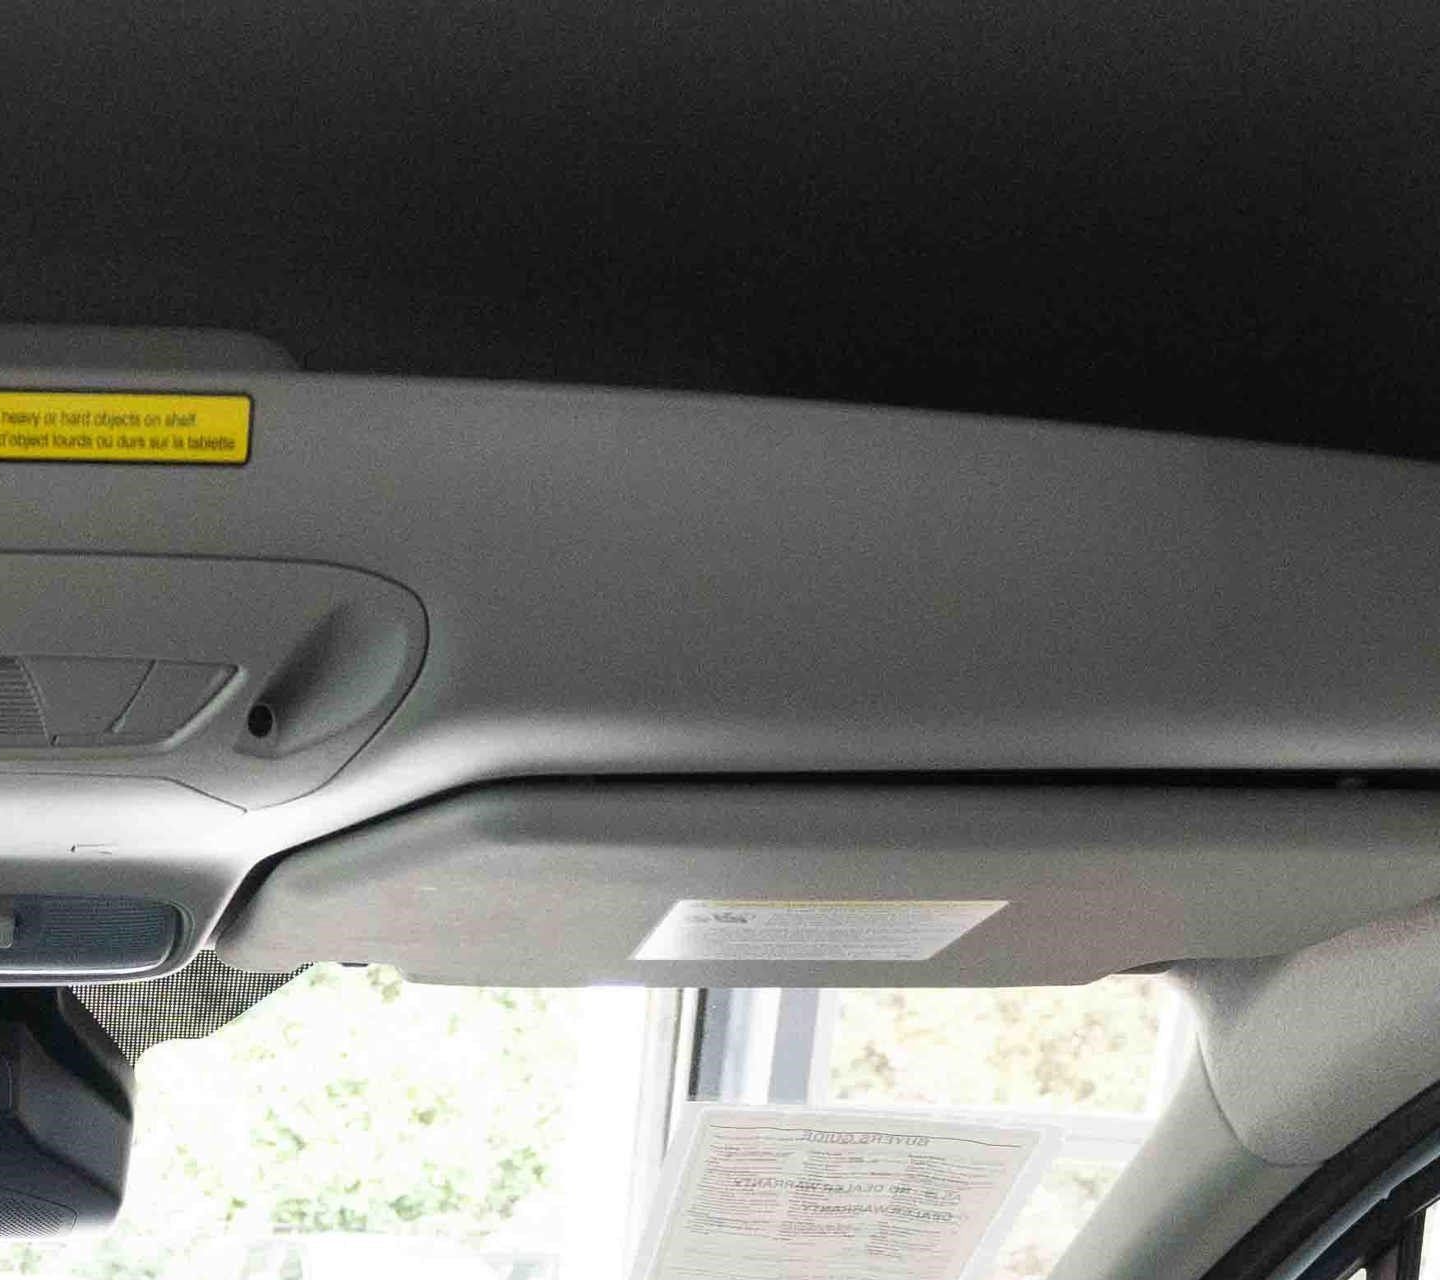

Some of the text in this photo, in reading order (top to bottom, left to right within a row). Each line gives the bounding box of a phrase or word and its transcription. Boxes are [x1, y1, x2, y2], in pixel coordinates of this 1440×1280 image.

[2, 411, 41, 428] heavy
[44, 412, 57, 426] or
[94, 411, 141, 430] objects
[144, 414, 161, 427] on
[53, 433, 92, 449] lourds
[149, 437, 168, 450] sur
[171, 435, 184, 450] la
